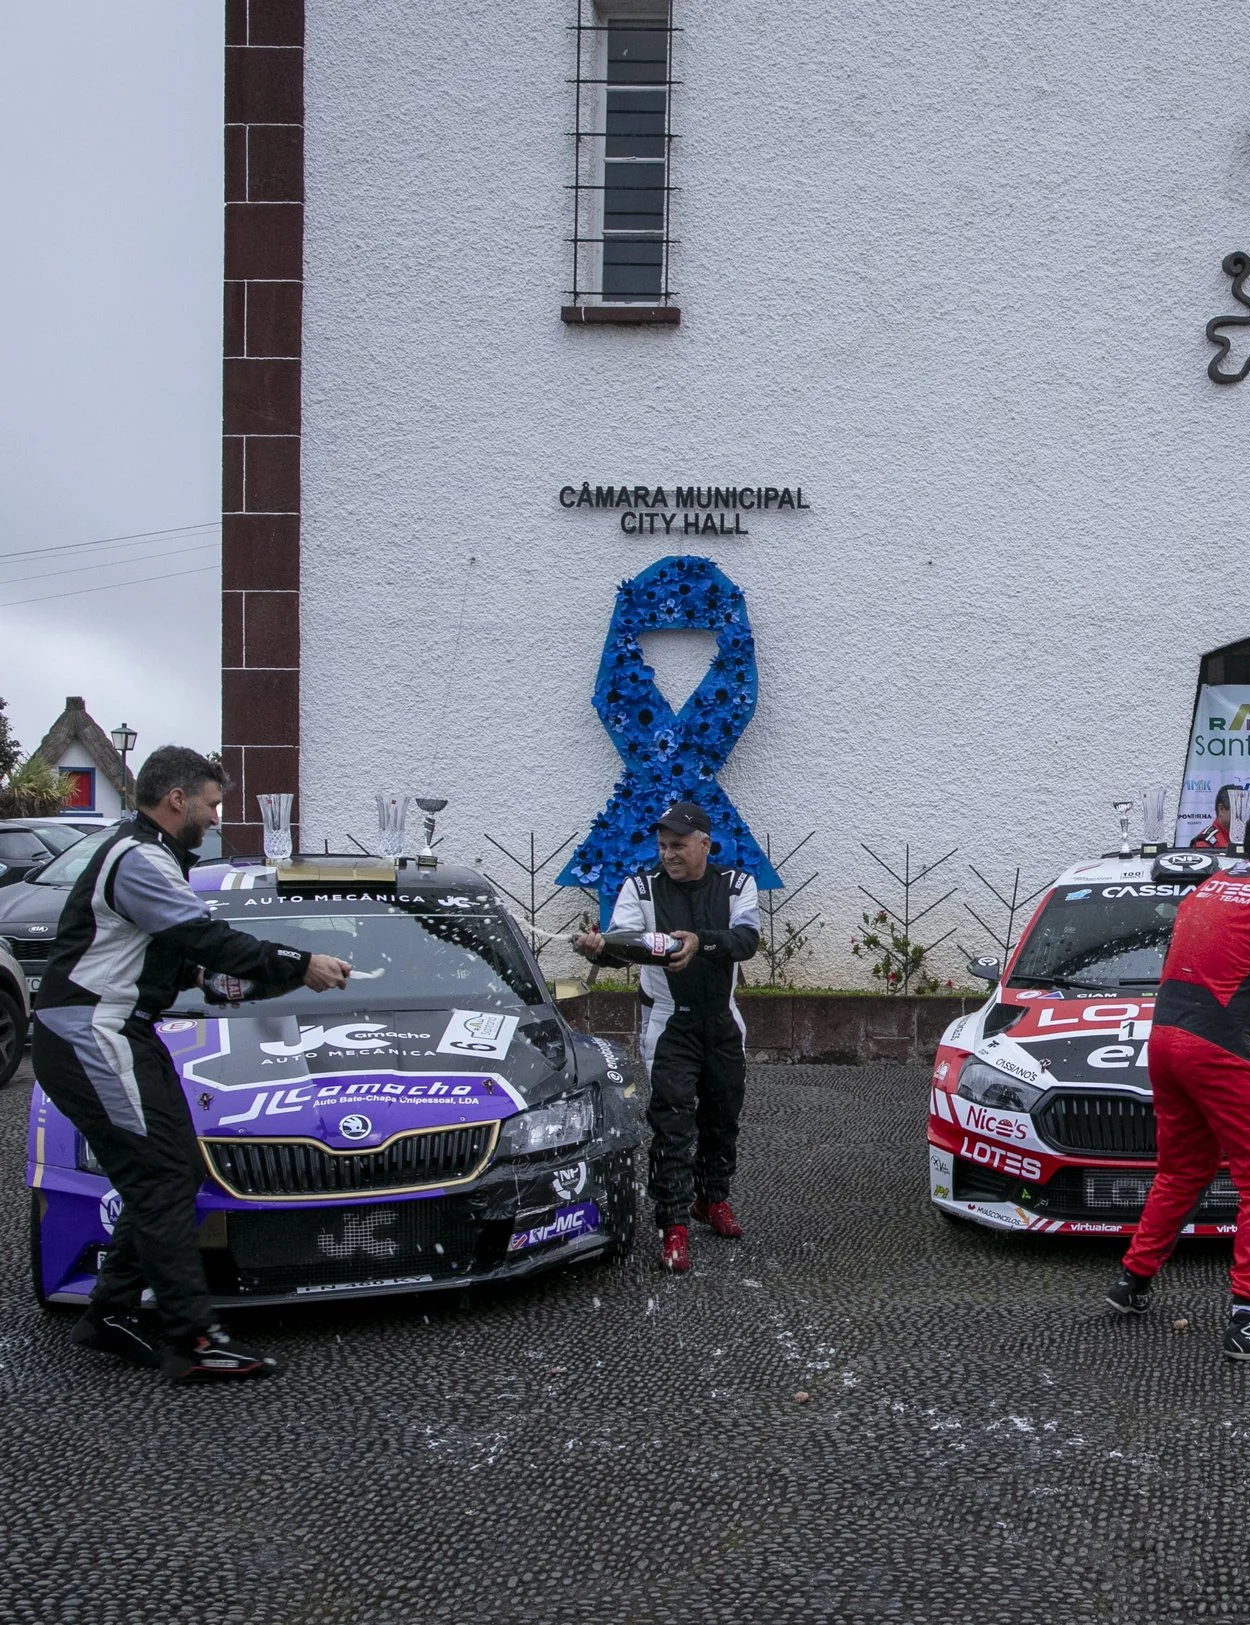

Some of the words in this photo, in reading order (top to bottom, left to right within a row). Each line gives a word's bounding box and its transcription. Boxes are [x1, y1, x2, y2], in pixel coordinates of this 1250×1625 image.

[559, 481, 669, 508] CÂMARA
[675, 486, 810, 509] MUNICIPAL
[620, 511, 677, 535] CITY
[683, 513, 749, 535] HALL
[244, 895, 304, 906] AUTO
[314, 892, 426, 903] MECÂNICA
[260, 1052, 317, 1065] AUTO
[995, 1058, 1038, 1082] CASSIANO'S
[313, 1097, 337, 1107] Auto
[340, 1094, 397, 1104] Bate-Chapa
[458, 1096, 479, 1105] LDA
[960, 1136, 1042, 1180] LOTES
[1070, 1223, 1123, 1232] virtualcar
